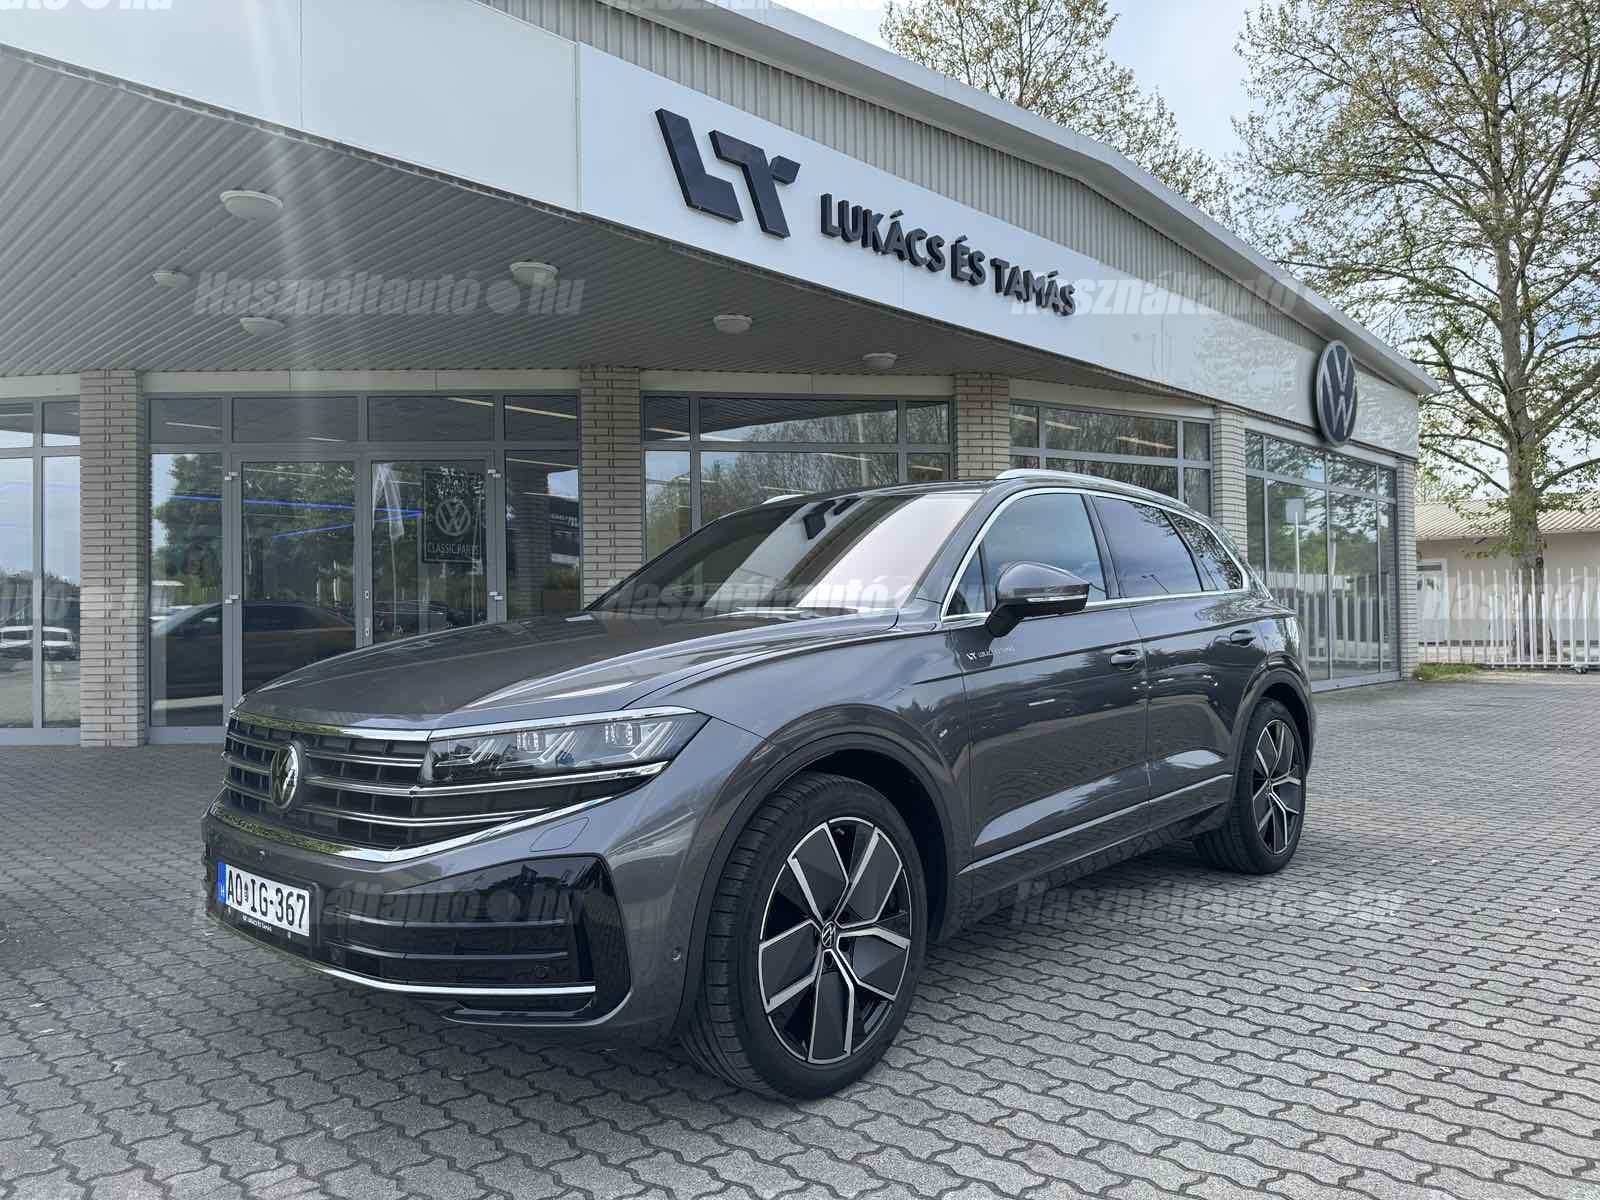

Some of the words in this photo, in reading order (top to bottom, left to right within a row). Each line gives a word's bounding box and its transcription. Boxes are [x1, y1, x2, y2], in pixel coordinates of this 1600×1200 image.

[655, 108, 800, 239] LT
[820, 193, 946, 273] LUKÁCS
[950, 234, 986, 287] ÉS
[990, 257, 1076, 317] TAMÁS
[250, 879, 306, 929] IG-367
